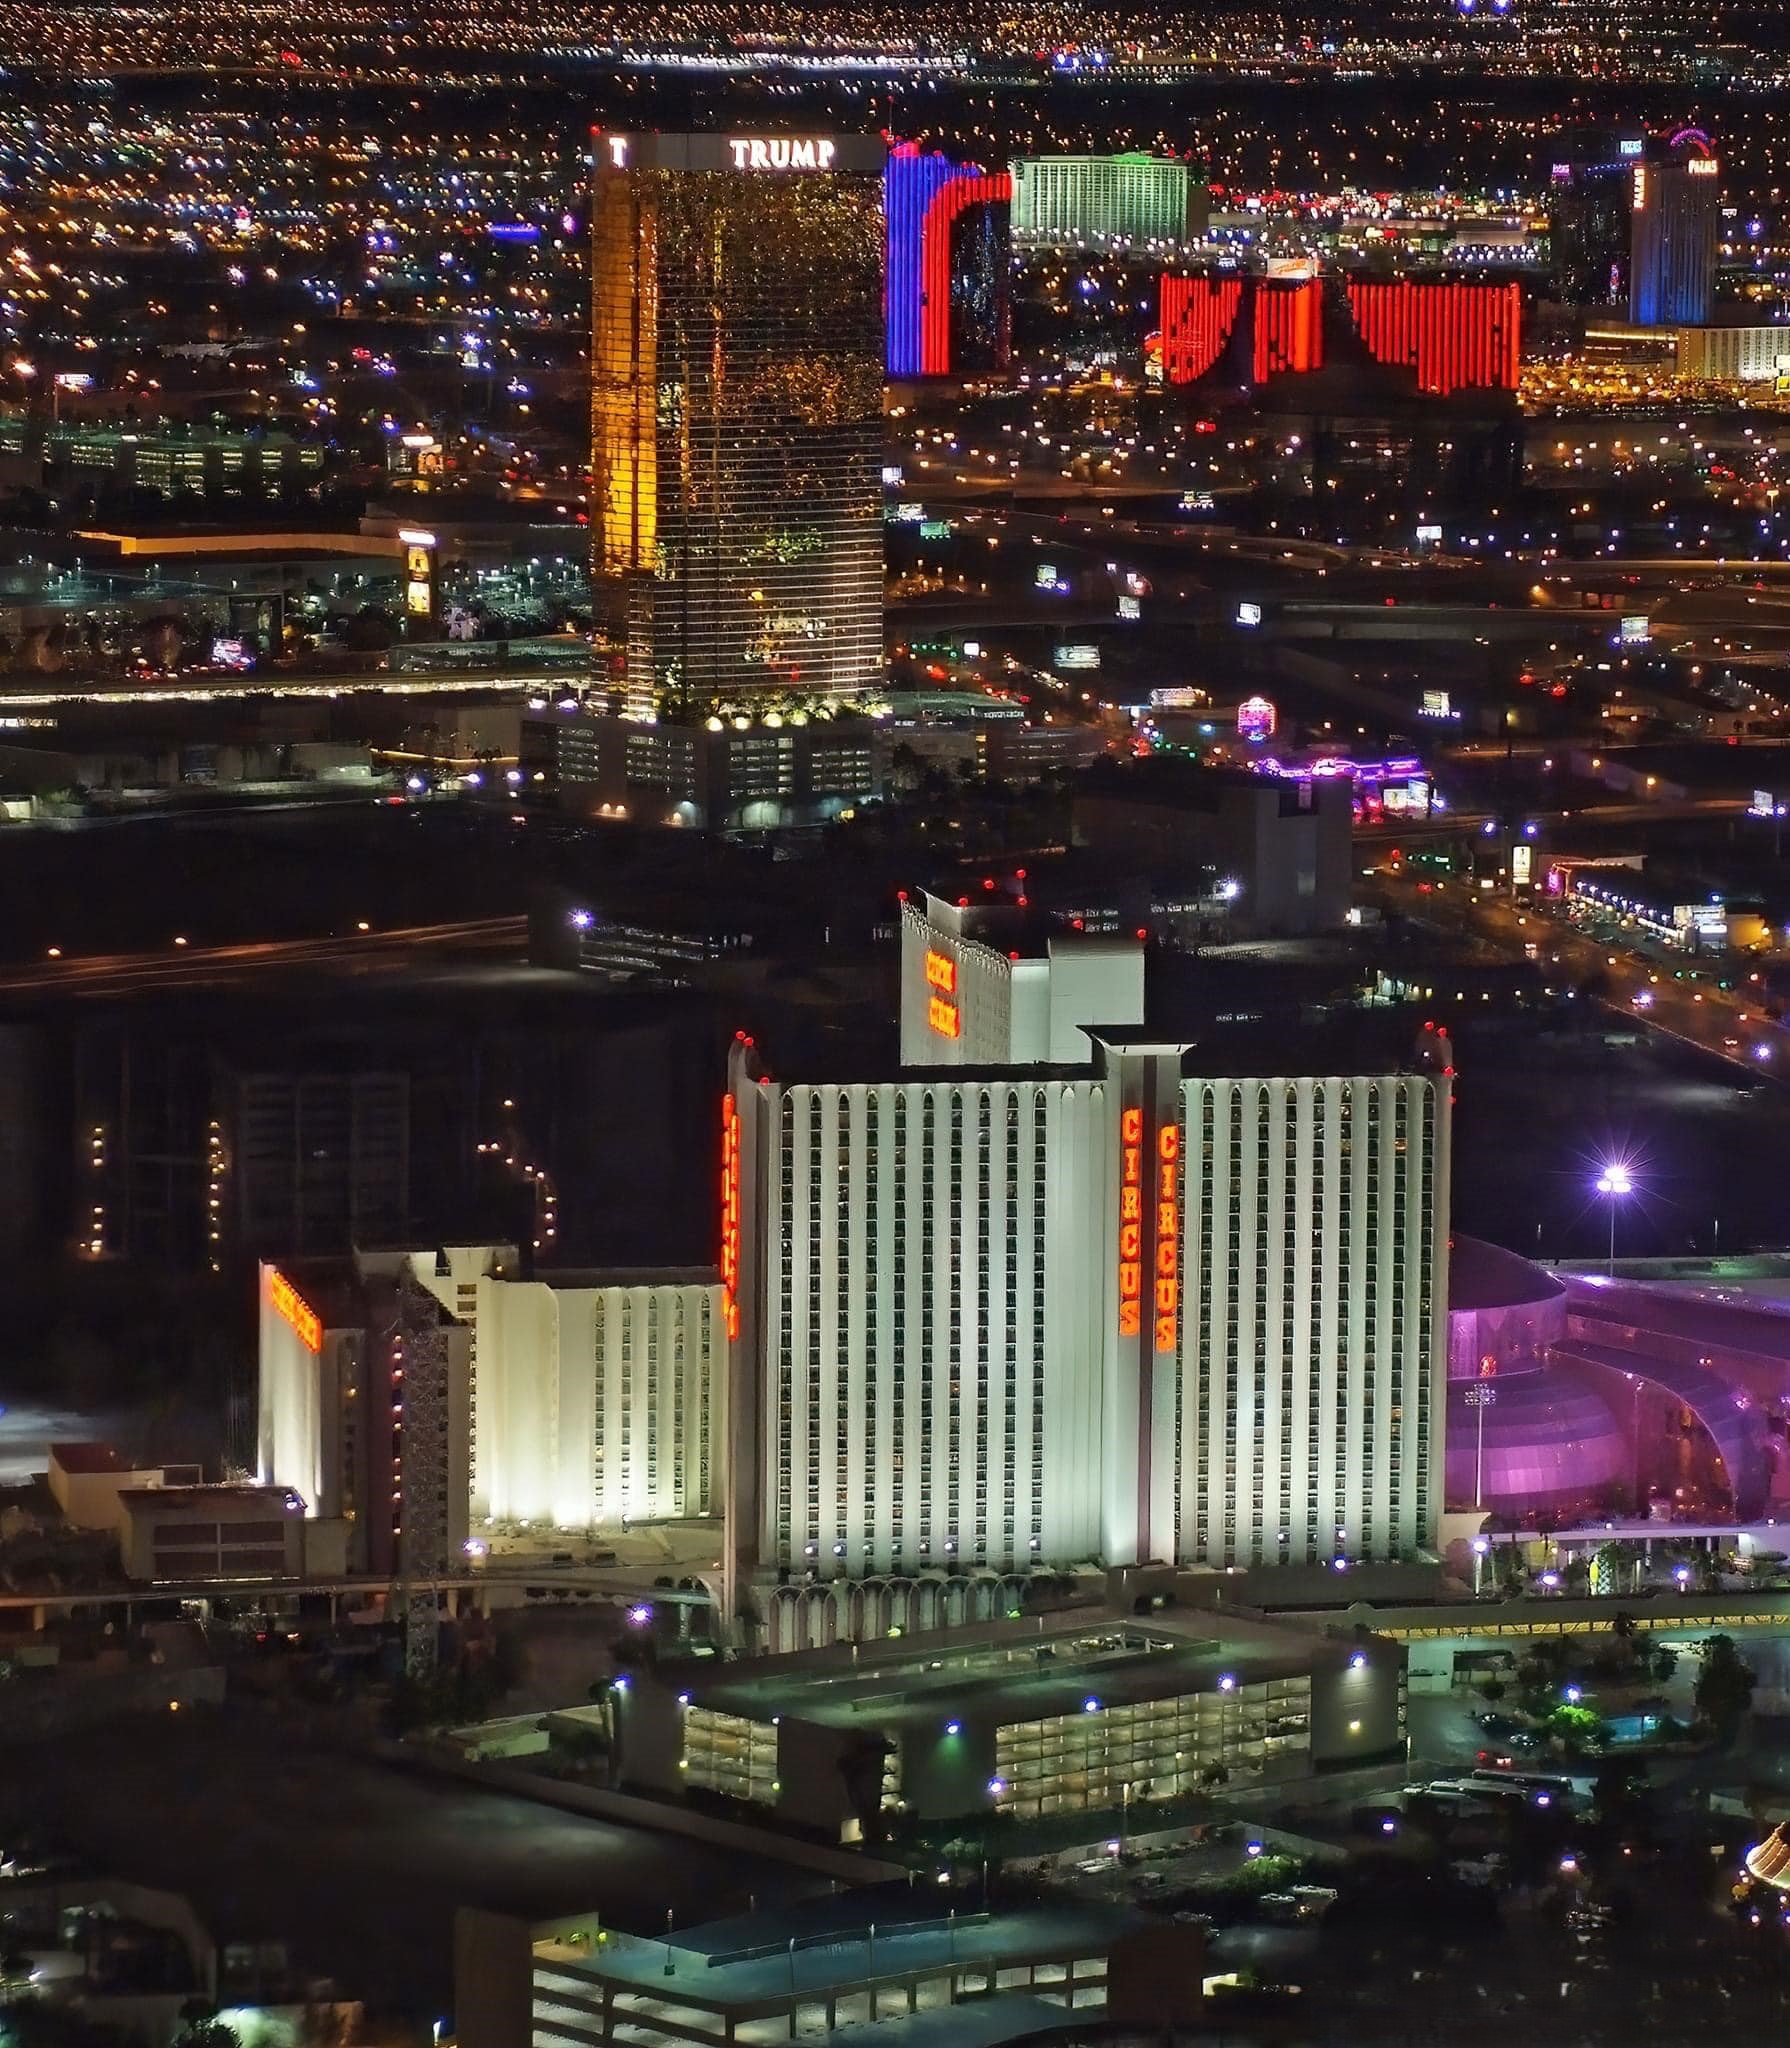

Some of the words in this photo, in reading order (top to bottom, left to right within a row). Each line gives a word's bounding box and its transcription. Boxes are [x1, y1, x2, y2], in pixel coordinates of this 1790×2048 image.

[609, 137, 627, 168] T
[729, 139, 835, 168] TRUMP
[1120, 1108, 1143, 1336] CIRCUS
[1156, 1125, 1178, 1353] CIRCUS
